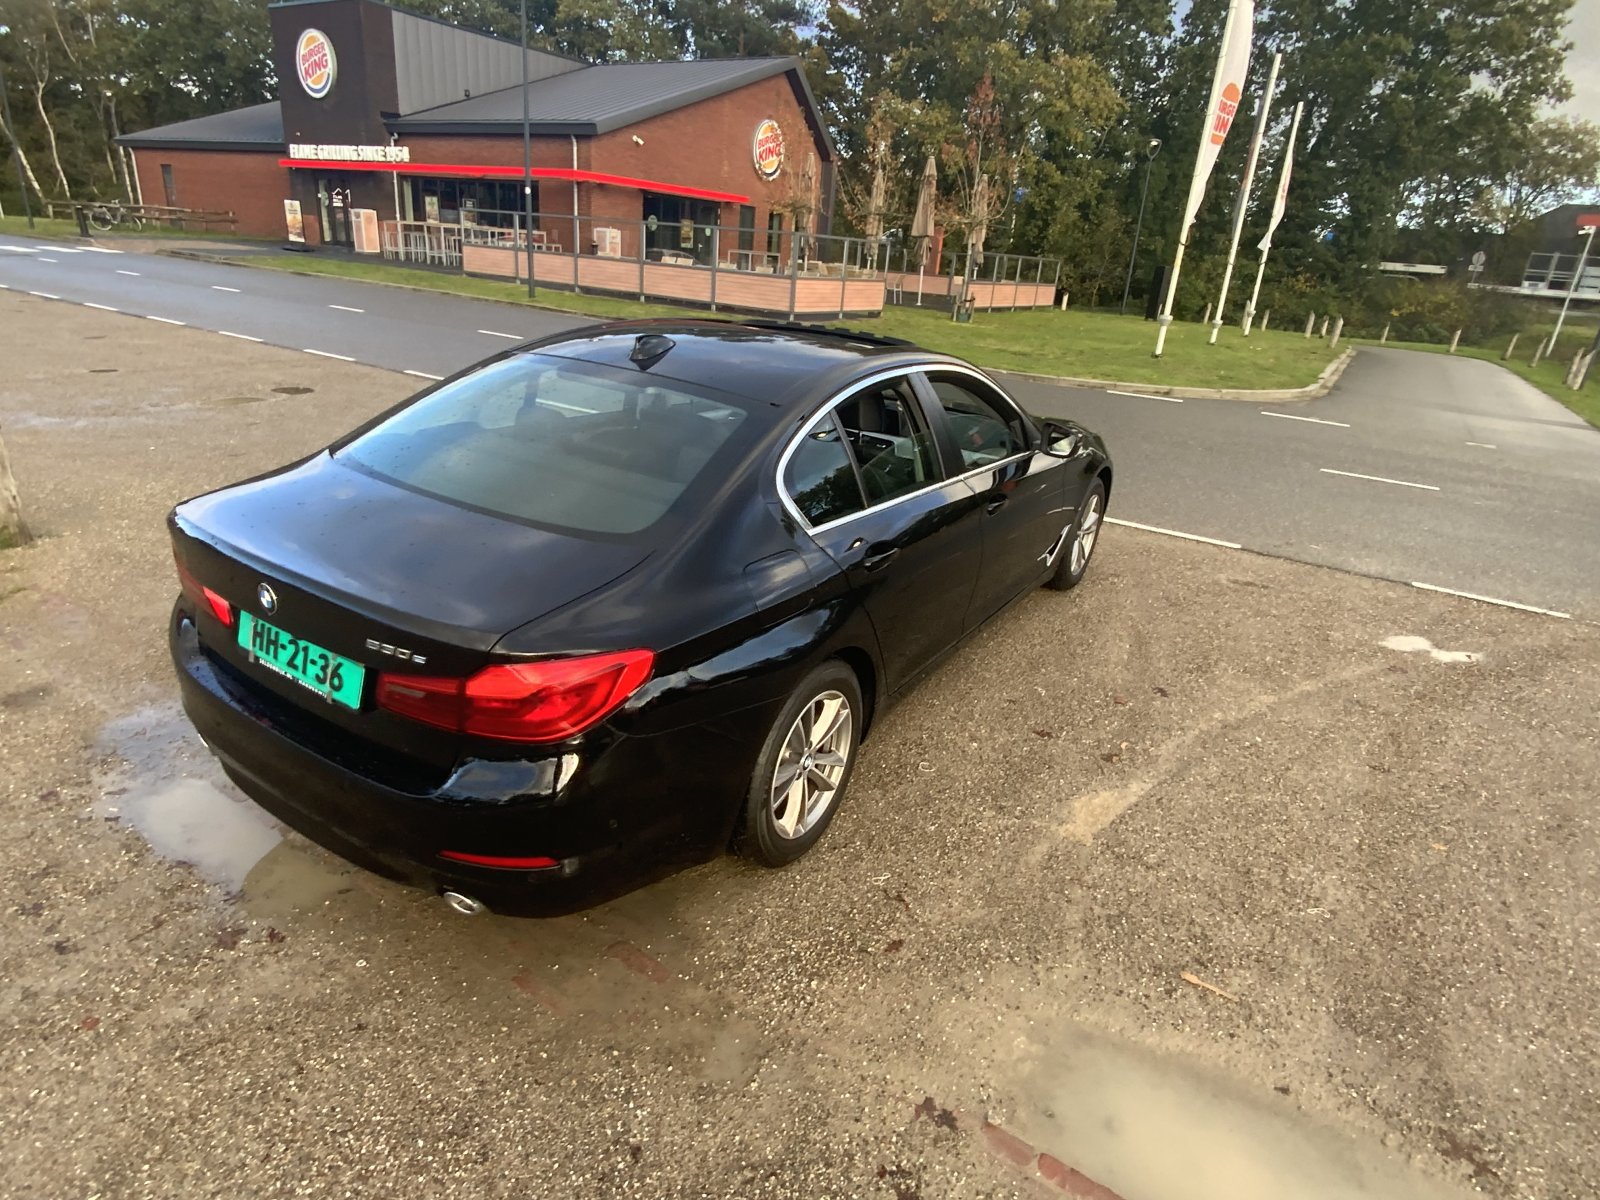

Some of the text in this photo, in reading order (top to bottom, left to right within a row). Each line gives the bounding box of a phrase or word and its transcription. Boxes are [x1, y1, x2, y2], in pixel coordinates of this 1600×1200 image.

[301, 42, 326, 66] BURGER
[304, 53, 329, 82] KING
[289, 144, 318, 159] FLAME
[318, 145, 357, 161] GRILLING
[357, 146, 386, 162] SINCE
[759, 144, 782, 162] KING
[252, 622, 344, 692] HH-21-36
